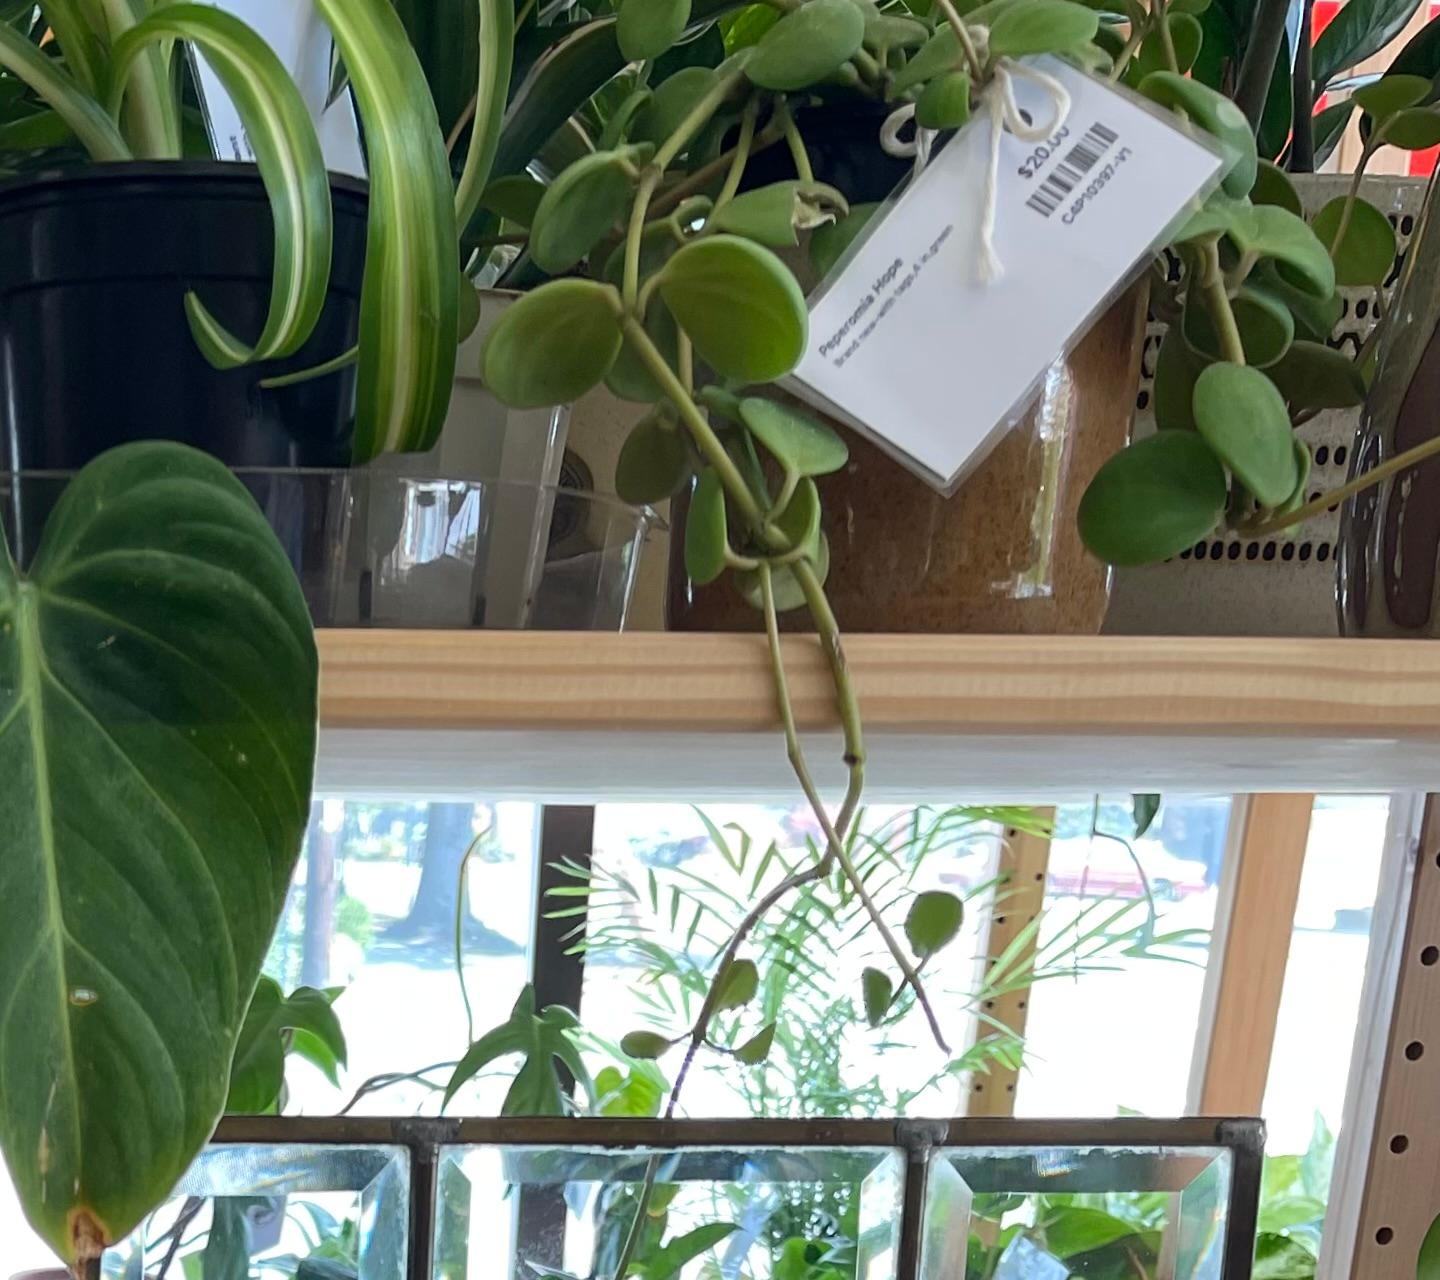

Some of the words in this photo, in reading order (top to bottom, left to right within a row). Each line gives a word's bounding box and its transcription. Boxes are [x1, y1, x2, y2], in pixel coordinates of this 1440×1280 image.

[818, 294, 875, 357] Peperomia
[872, 257, 904, 295] Hope
[833, 338, 860, 368] Brand
